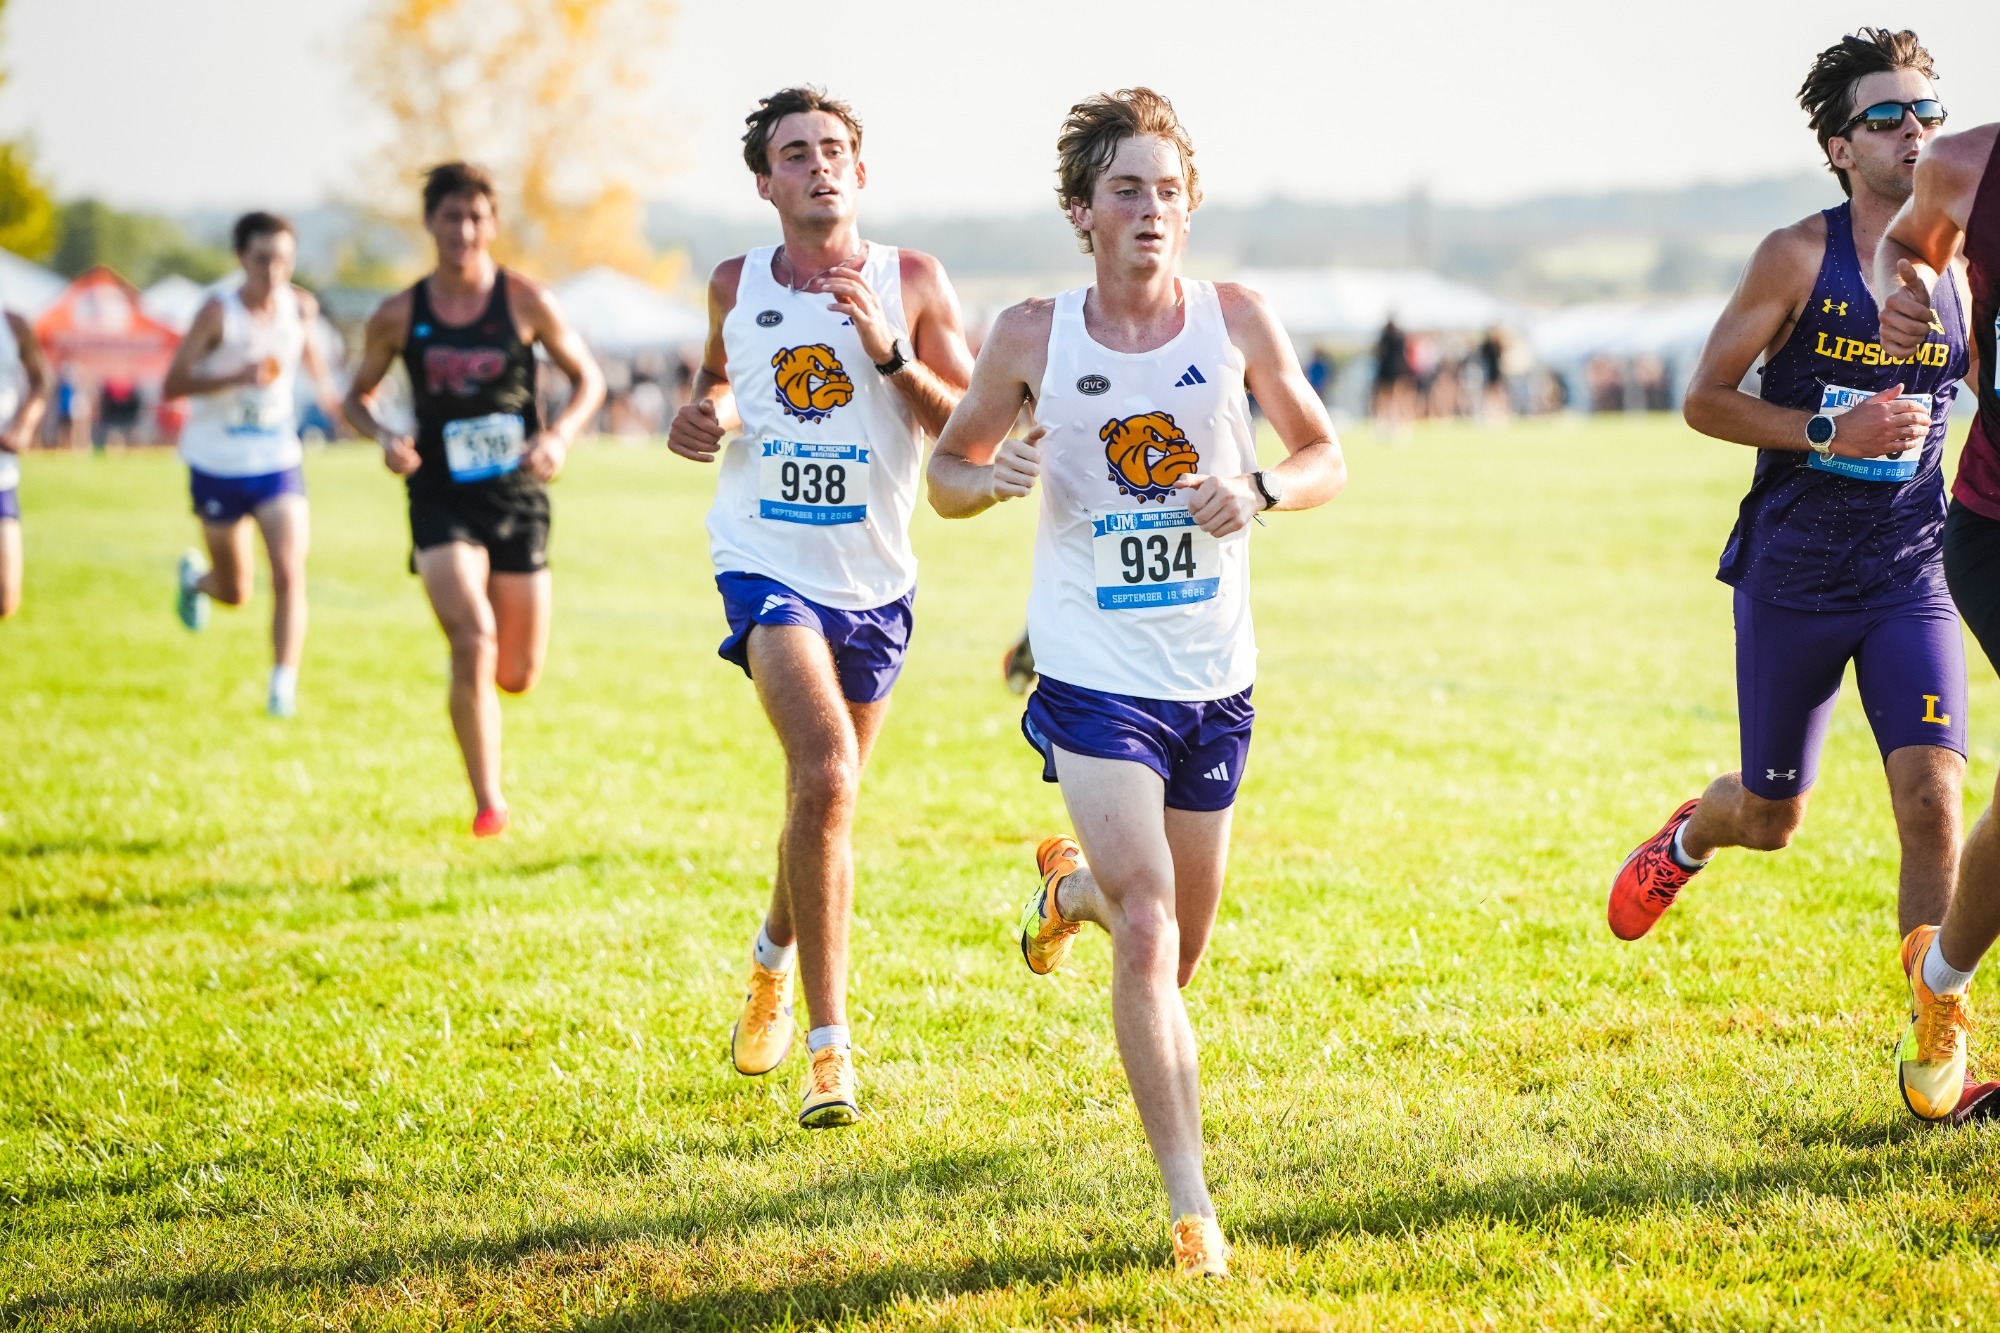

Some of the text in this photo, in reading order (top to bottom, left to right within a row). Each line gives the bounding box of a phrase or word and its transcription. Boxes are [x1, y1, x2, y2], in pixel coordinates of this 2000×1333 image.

[1084, 380, 1102, 390] OVC
[777, 442, 795, 456] JM
[800, 444, 817, 452] JOHN
[1886, 468, 1906, 476] 2026
[781, 461, 846, 505] 938
[771, 508, 813, 519] SEPTEMBER
[831, 511, 852, 520] 2026
[1141, 511, 1194, 522] JOHN MCNICHOL
[1112, 514, 1135, 531] JM
[1153, 519, 1186, 528] INVITATIONAL
[1120, 532, 1197, 585] 934
[1112, 591, 1163, 604] SEPTEMBER
[1181, 587, 1205, 599] 2026
[1922, 694, 1951, 727] L
